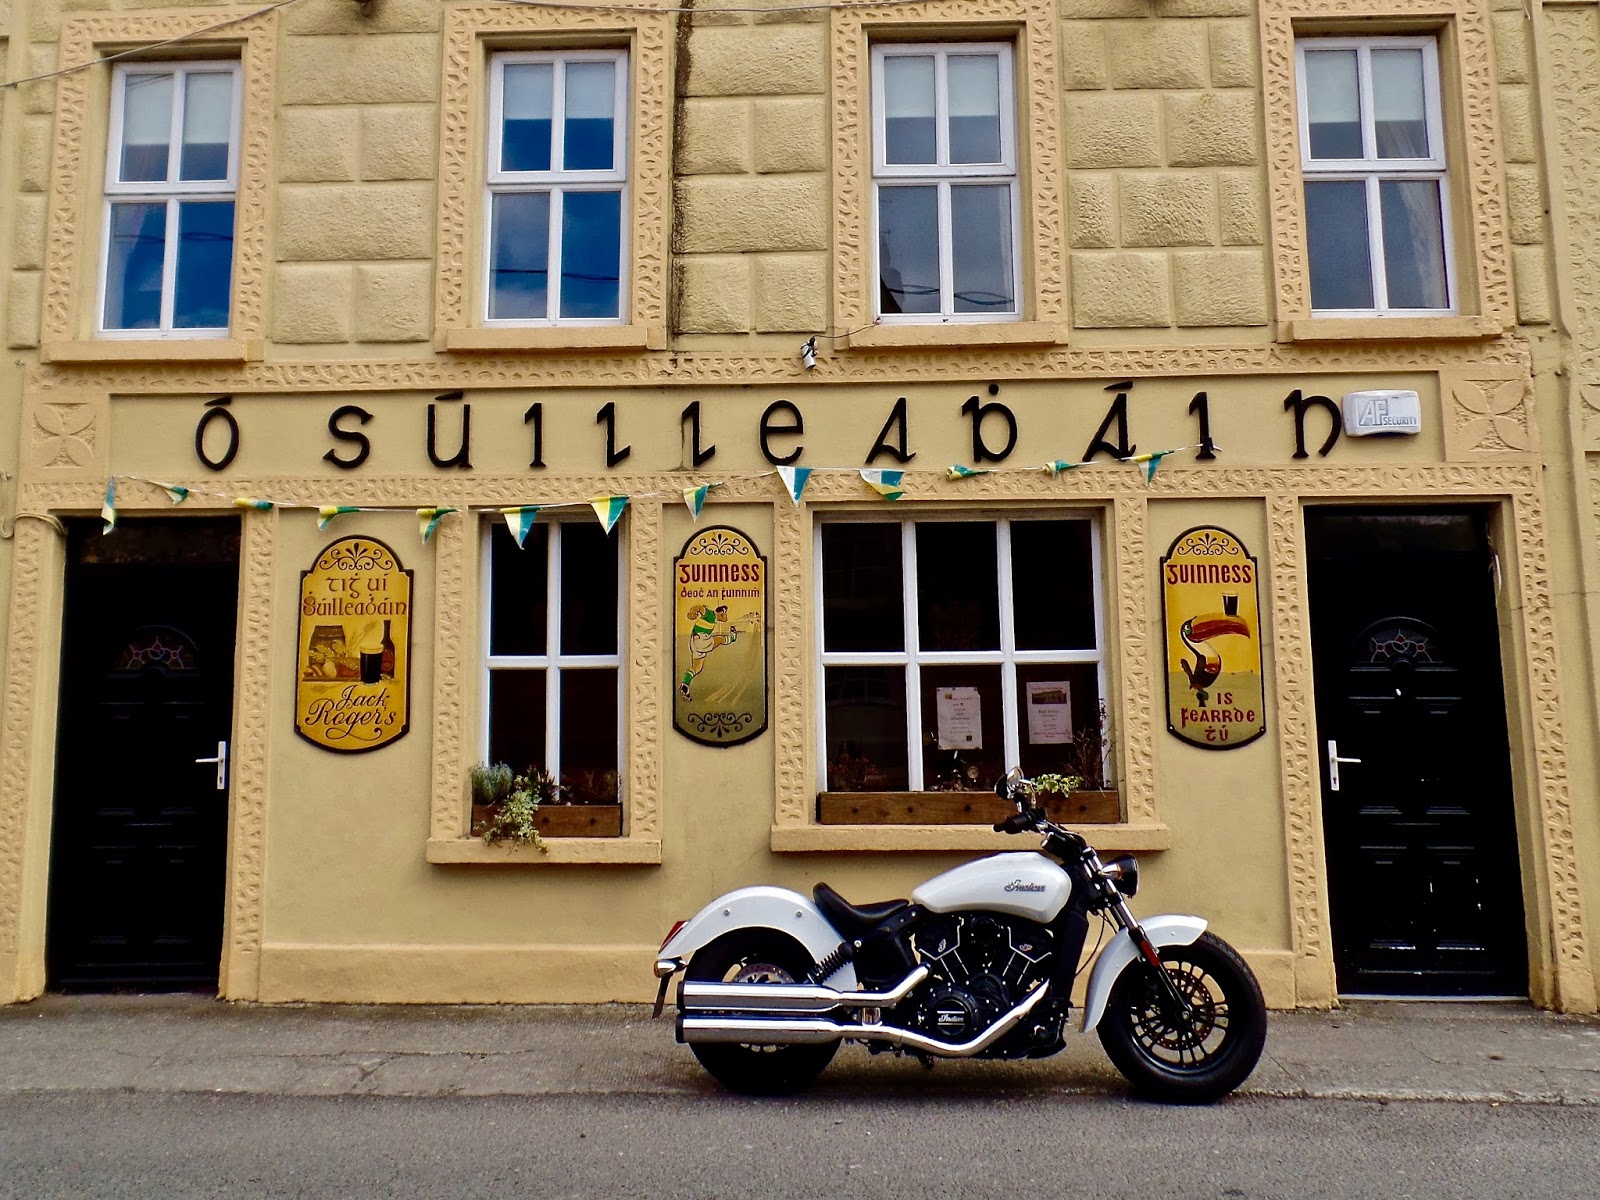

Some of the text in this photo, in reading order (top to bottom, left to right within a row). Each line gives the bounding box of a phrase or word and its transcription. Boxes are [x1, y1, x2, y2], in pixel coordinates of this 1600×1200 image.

[1359, 399, 1388, 426] AF
[195, 396, 240, 471] Ó
[335, 685, 390, 712] Jack
[304, 698, 397, 742] Roger's
